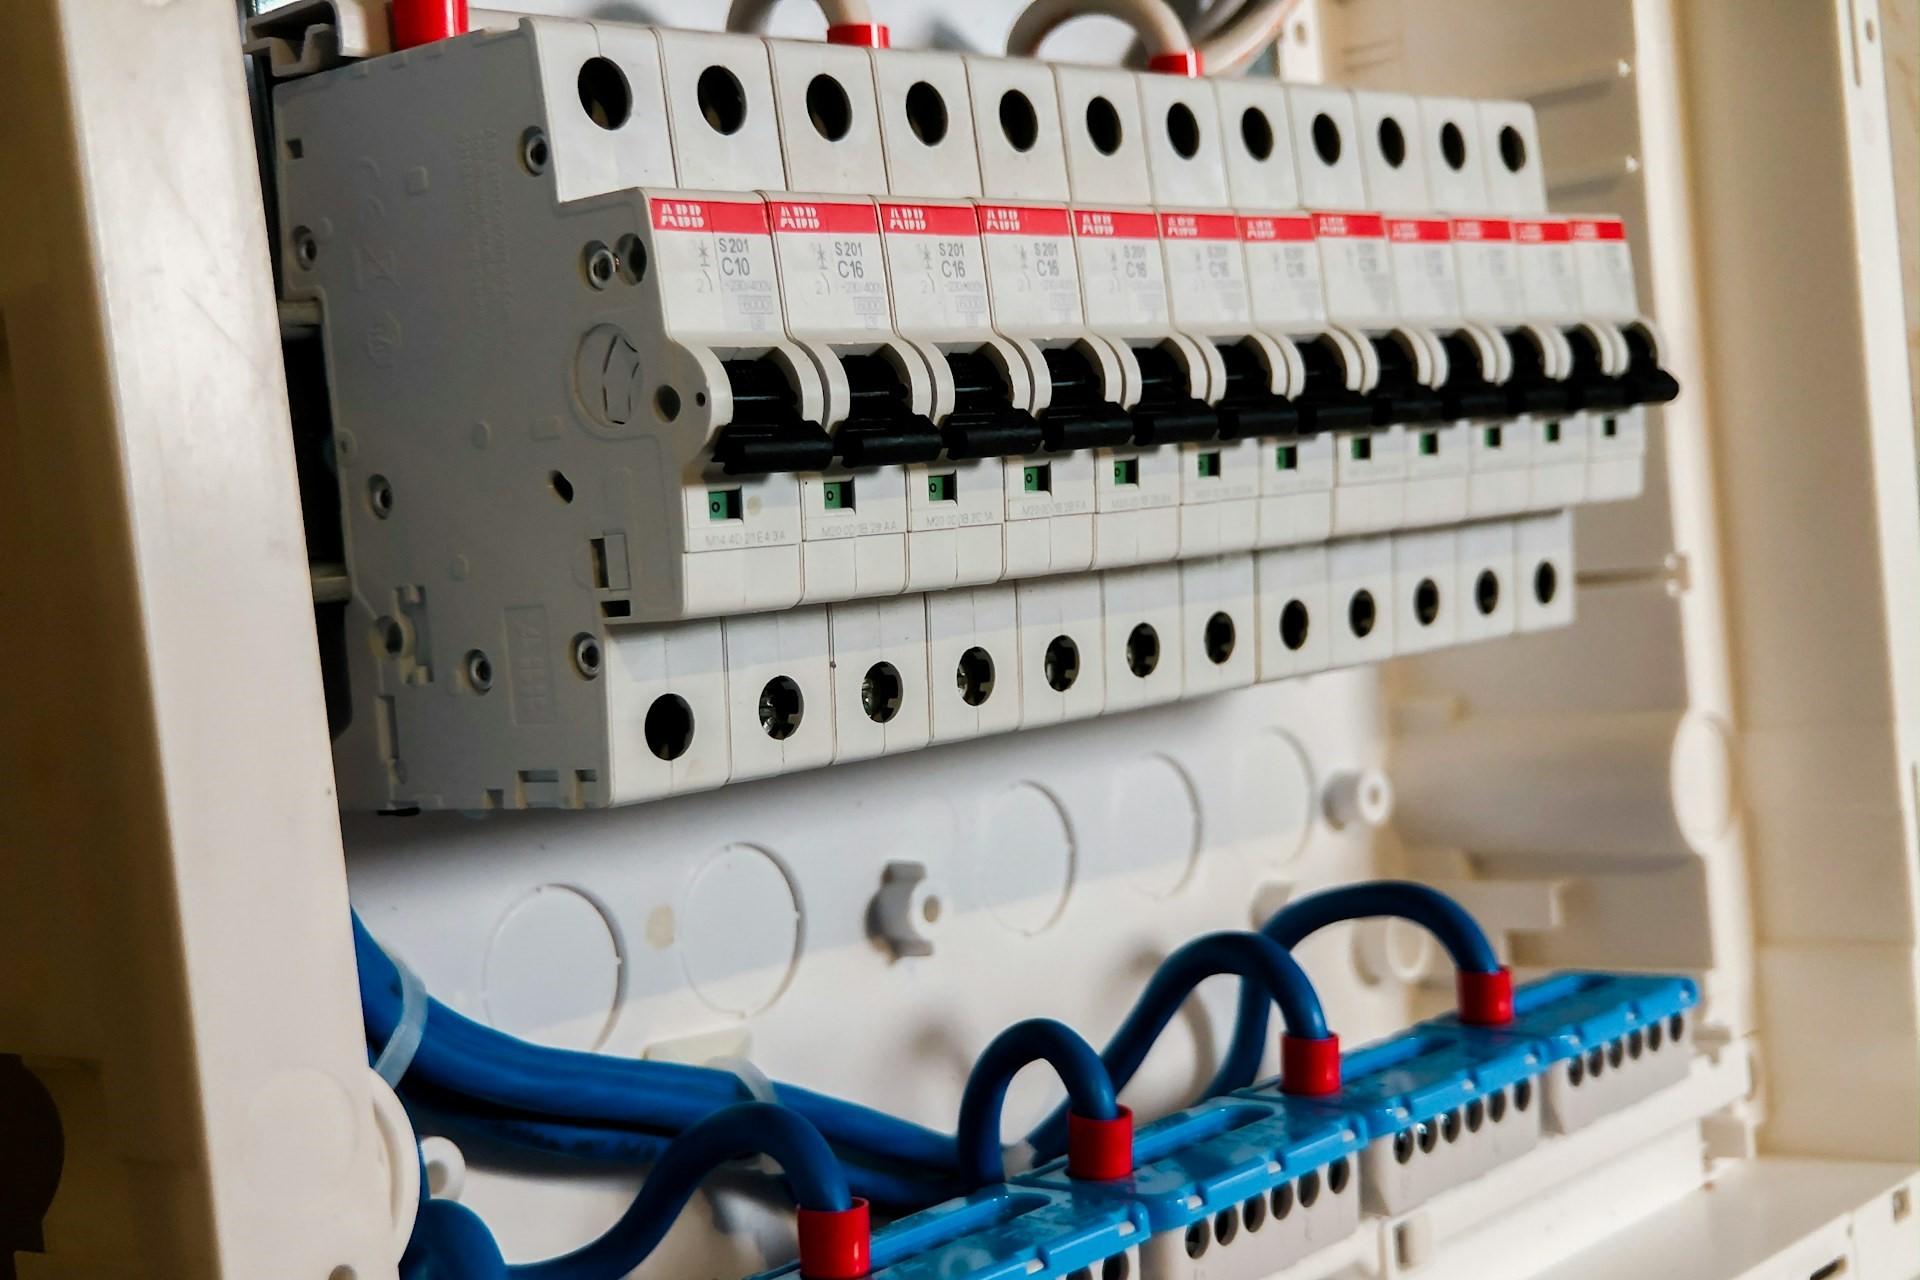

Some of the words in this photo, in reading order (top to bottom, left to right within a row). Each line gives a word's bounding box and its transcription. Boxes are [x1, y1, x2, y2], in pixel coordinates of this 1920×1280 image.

[661, 203, 705, 228] ABB
[780, 206, 820, 230] ABB
[889, 207, 926, 231] ABB
[986, 209, 1021, 231] ABB
[1082, 213, 1114, 236] ABB
[722, 257, 750, 276] C10
[837, 260, 864, 279] C16
[941, 260, 966, 279] C16
